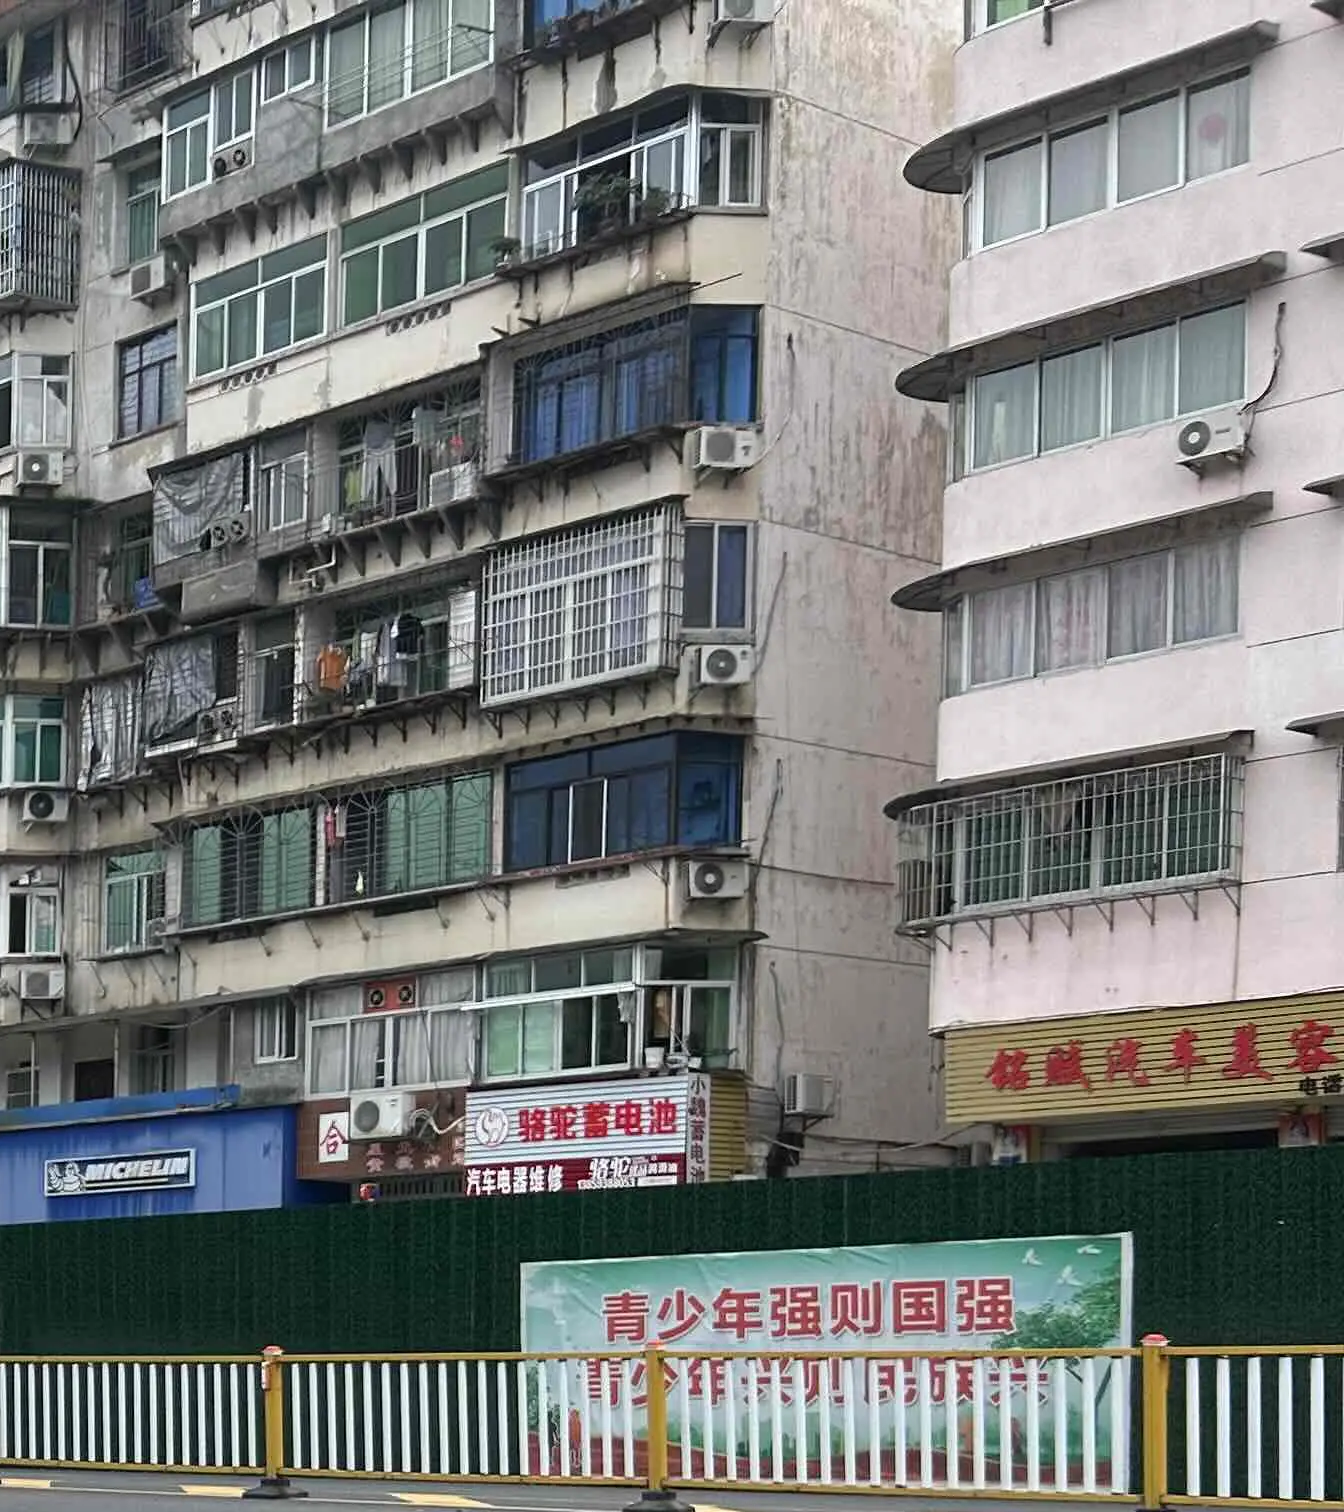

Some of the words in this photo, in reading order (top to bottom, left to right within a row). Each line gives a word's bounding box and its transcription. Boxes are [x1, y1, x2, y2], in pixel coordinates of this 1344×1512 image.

[518, 1098, 677, 1142] 骆驼蓄电池
[85, 1157, 189, 1181] MICHELIN
[466, 1164, 564, 1196] 汽车电器维修
[602, 1277, 1016, 1343] 青少年强则国强
